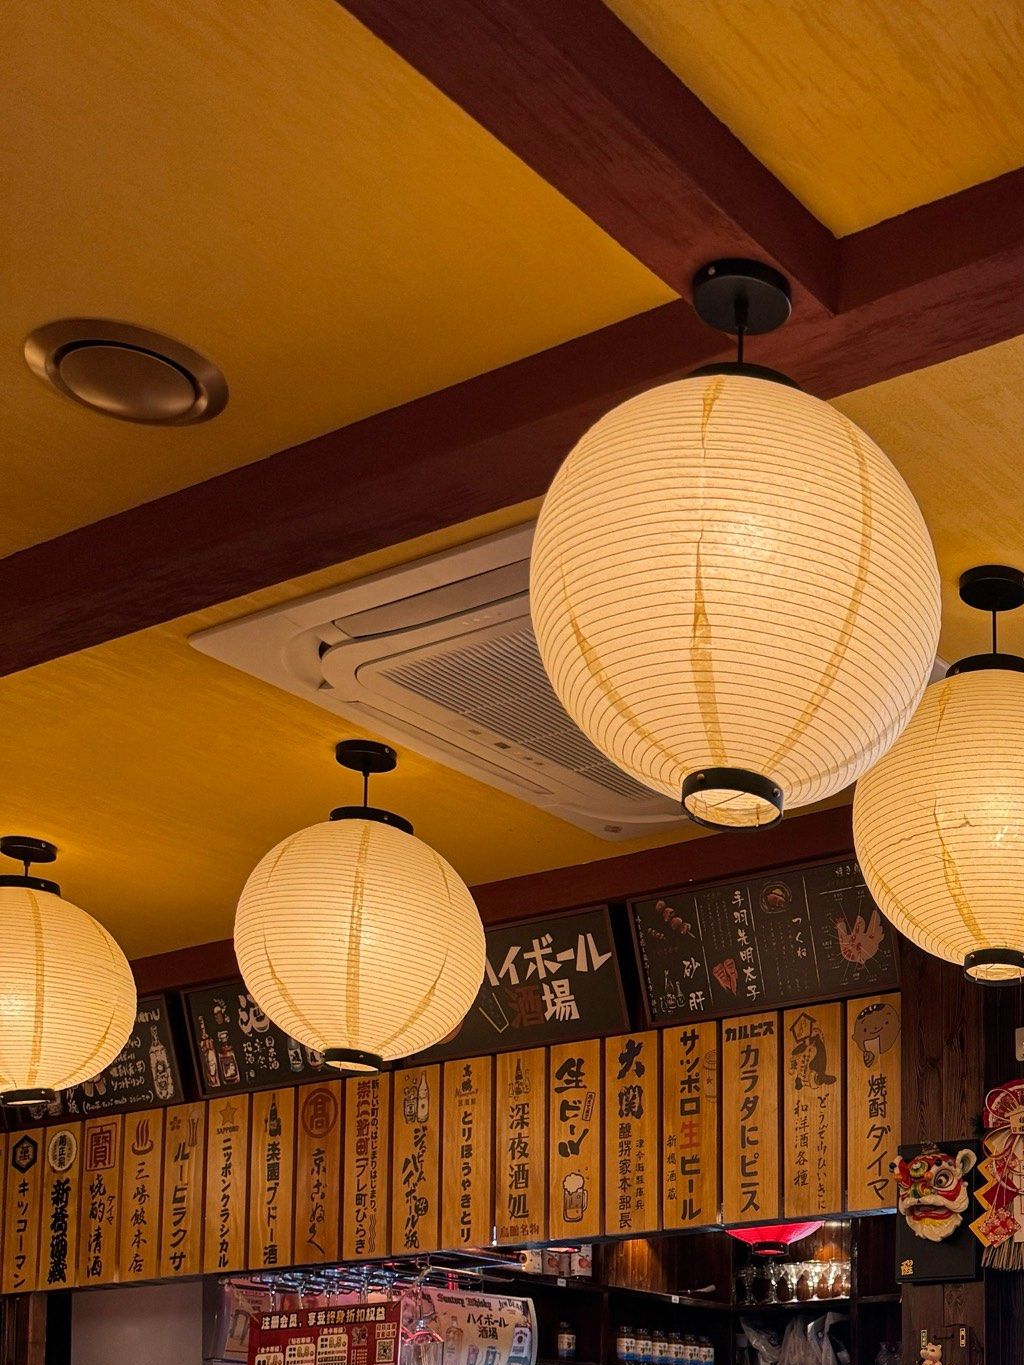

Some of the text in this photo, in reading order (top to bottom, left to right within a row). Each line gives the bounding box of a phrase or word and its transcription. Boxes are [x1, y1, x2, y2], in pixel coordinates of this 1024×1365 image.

[682, 957, 705, 1012] 砂肝
[731, 890, 761, 1001] 手羽先明太子
[792, 916, 807, 958] つくね
[504, 979, 580, 1028] 酒場
[725, 1021, 775, 1042] カルピス
[508, 1103, 530, 1220] 深夜酒処
[555, 1057, 589, 1157] 生ビール
[680, 1029, 701, 1220] サッポロ生ビール
[740, 1045, 760, 1213] カラダにピース
[14, 1177, 29, 1288] キッコーマン
[217, 1138, 232, 1268] ニッポンクラシカル
[263, 1141, 281, 1265] 楽園ブドー酒
[460, 1113, 473, 1243] とりほうやきとり
[467, 1314, 509, 1328] ハイボール
